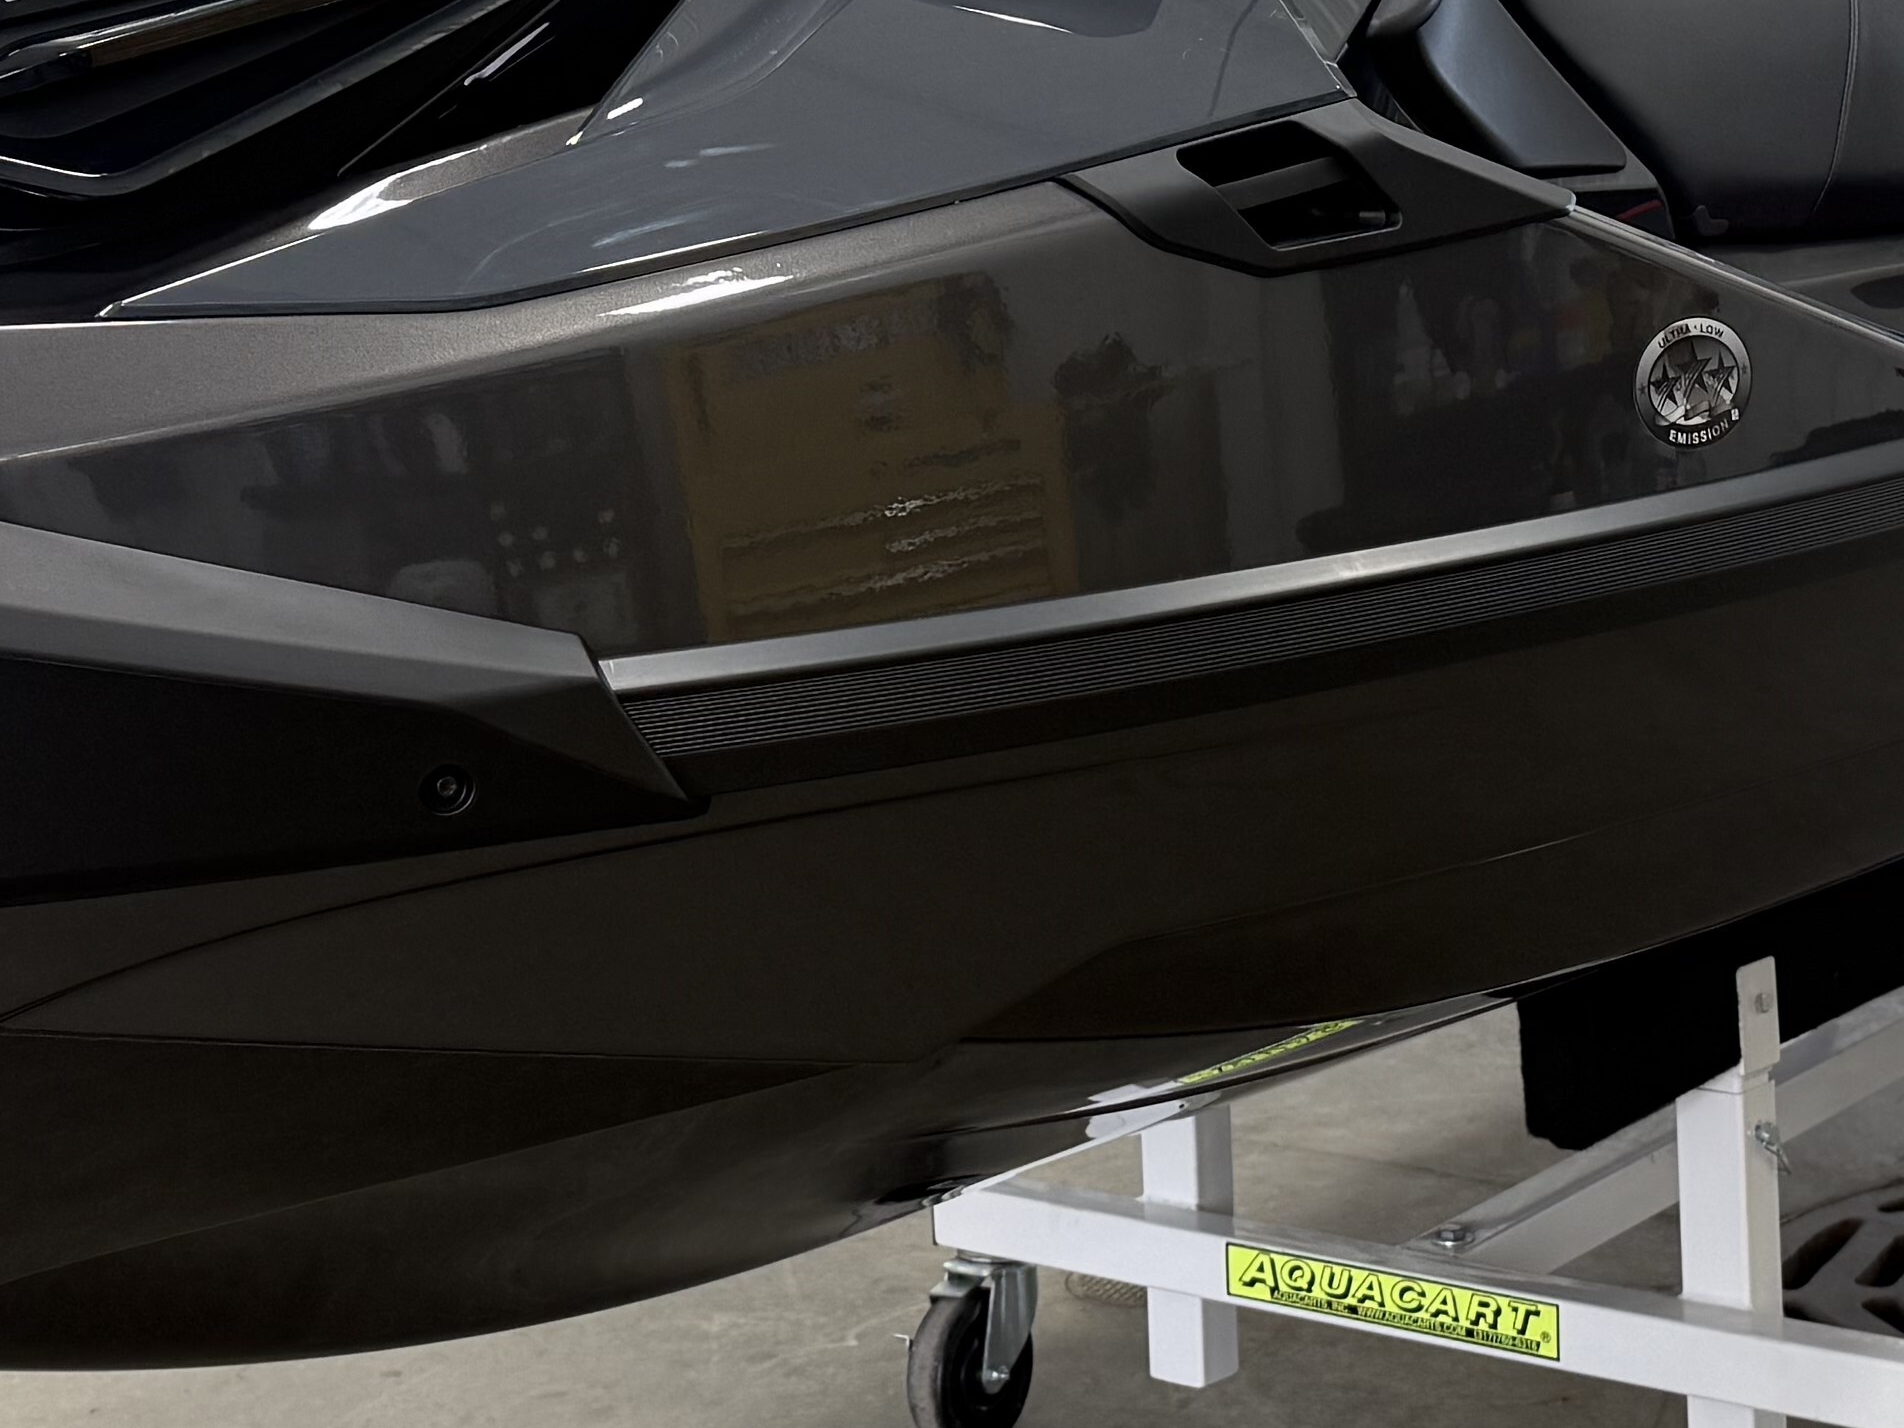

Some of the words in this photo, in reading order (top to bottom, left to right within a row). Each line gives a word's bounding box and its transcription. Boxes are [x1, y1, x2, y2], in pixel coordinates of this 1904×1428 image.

[1657, 323, 1692, 349] ULTRA
[1699, 322, 1725, 339] LOW
[1668, 419, 1730, 446] EMISSION
[1238, 1252, 1542, 1336] AQUACART
